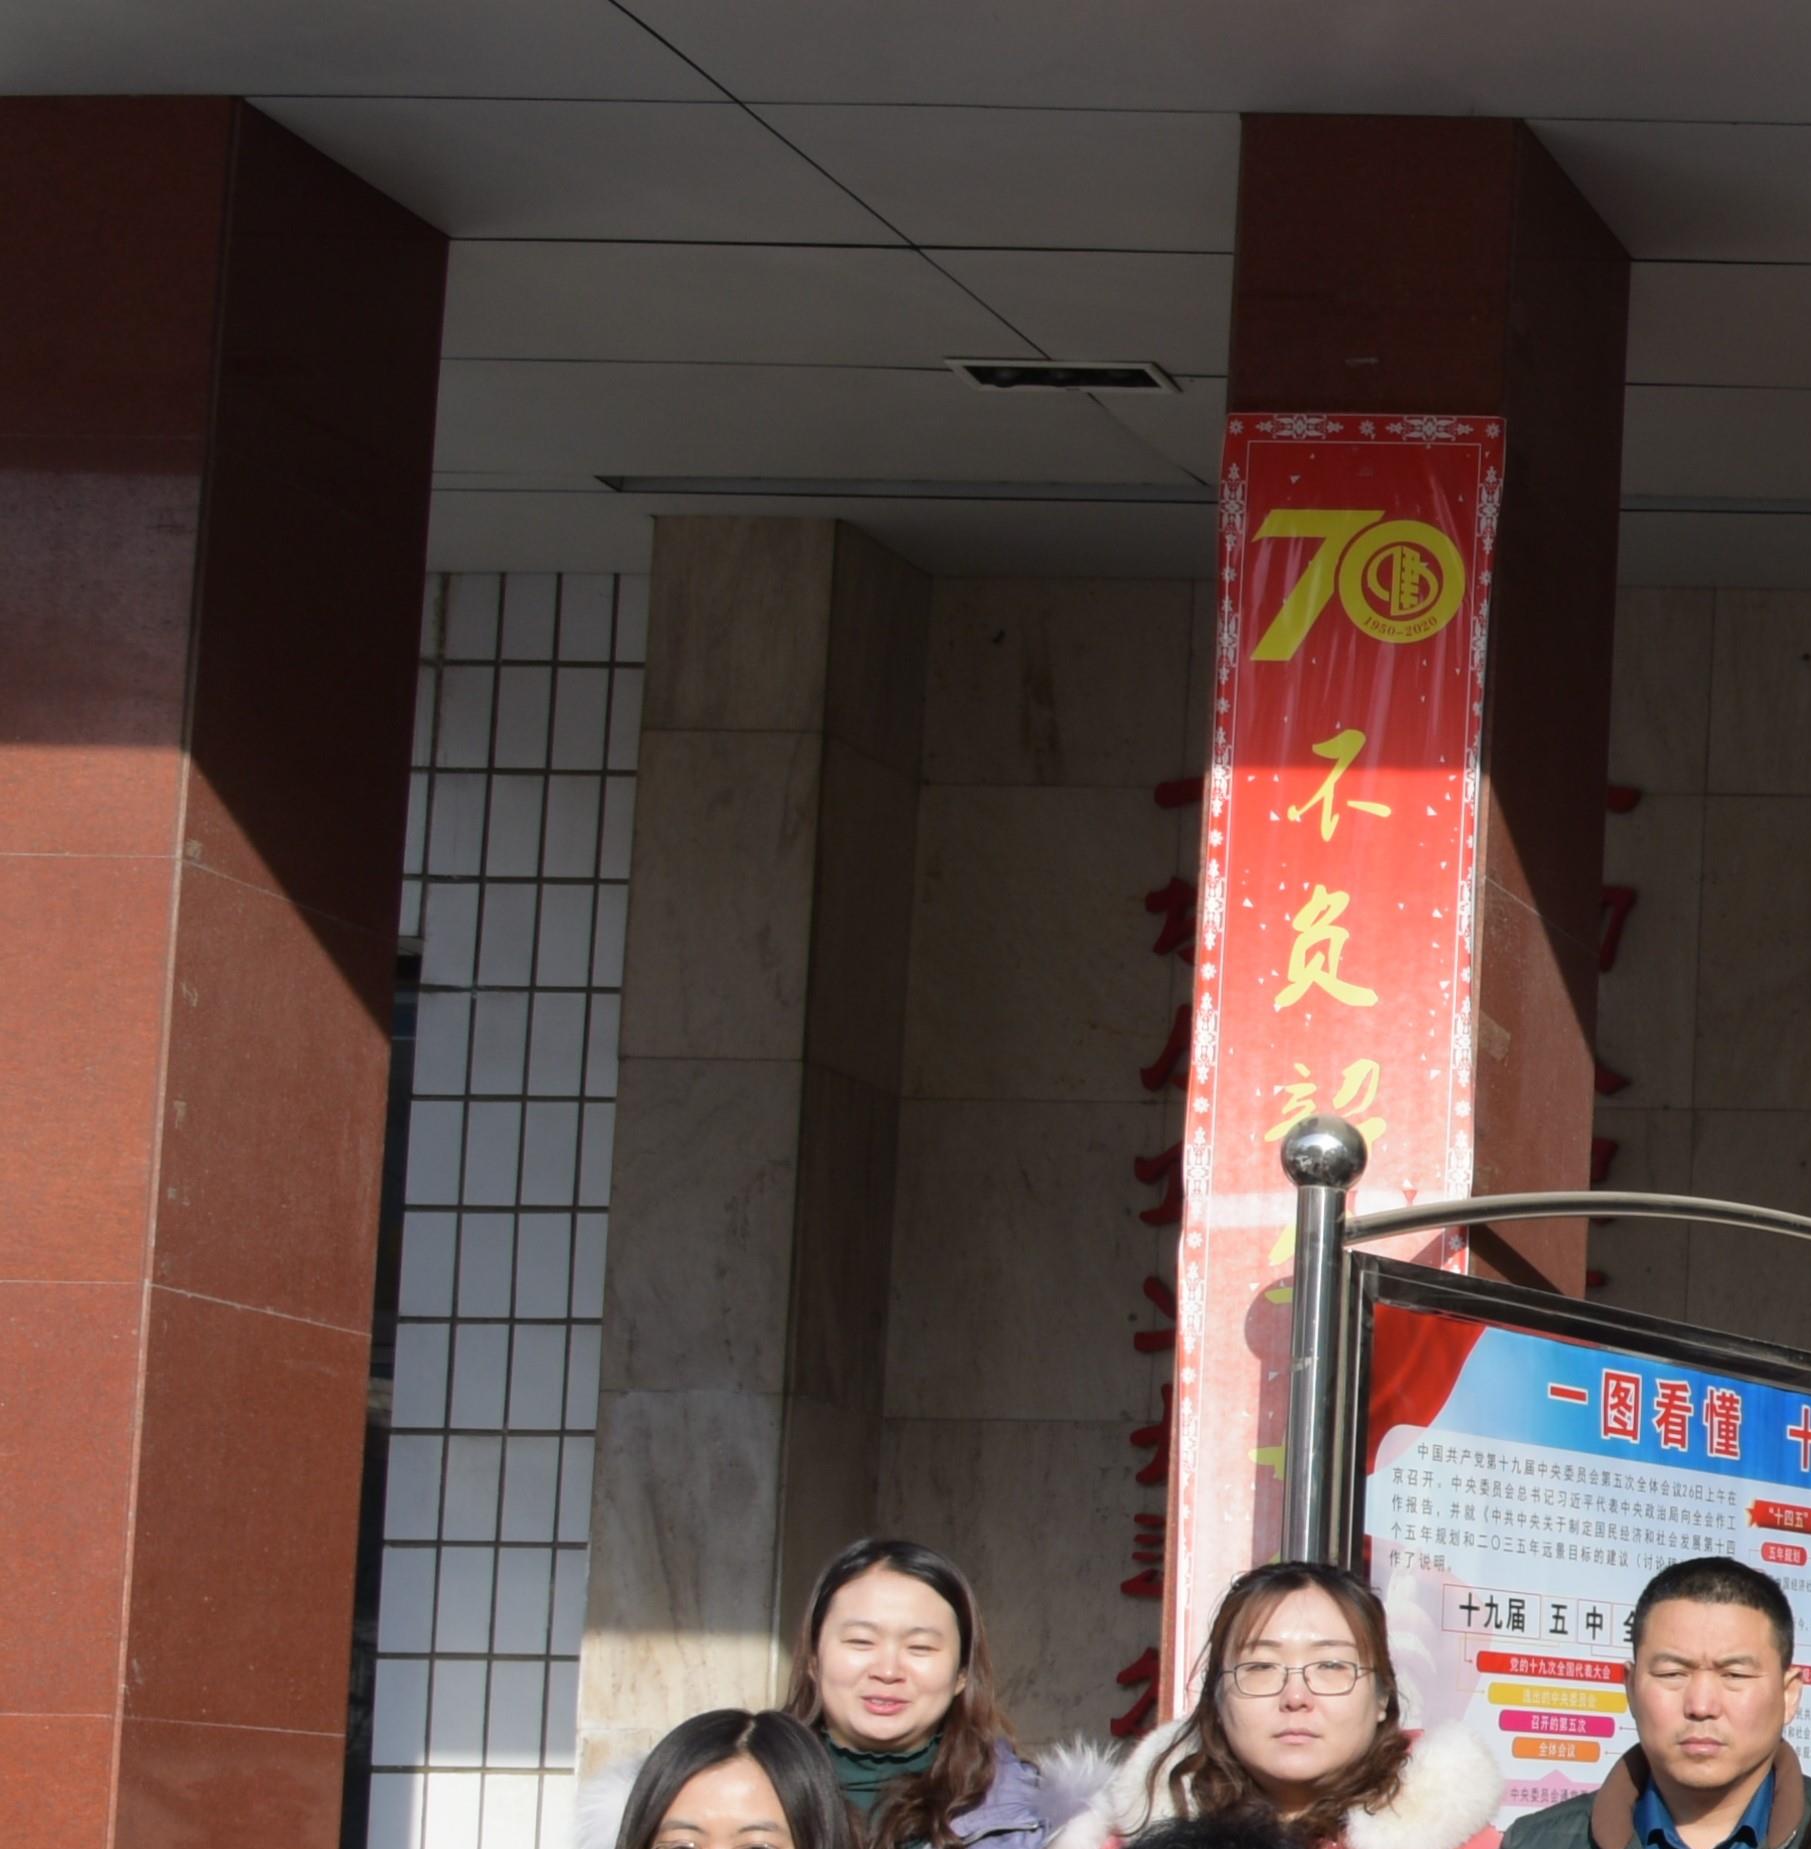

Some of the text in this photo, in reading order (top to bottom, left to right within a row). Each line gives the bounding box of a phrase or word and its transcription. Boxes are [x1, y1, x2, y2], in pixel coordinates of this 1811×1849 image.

[1250, 509, 1465, 661] 70
[1362, 615, 1438, 637] 1950-2020
[1547, 1367, 1743, 1460] 一图看懂
[1458, 1592, 1527, 1634] 十九届
[1549, 1603, 1569, 1636] 五
[1585, 1605, 1604, 1642] 中
[1508, 1656, 1612, 1682] 党的十九次全国代表大会
[1530, 1713, 1588, 1735] 召开的第五次
[1538, 1741, 1577, 1760] 全体会议
